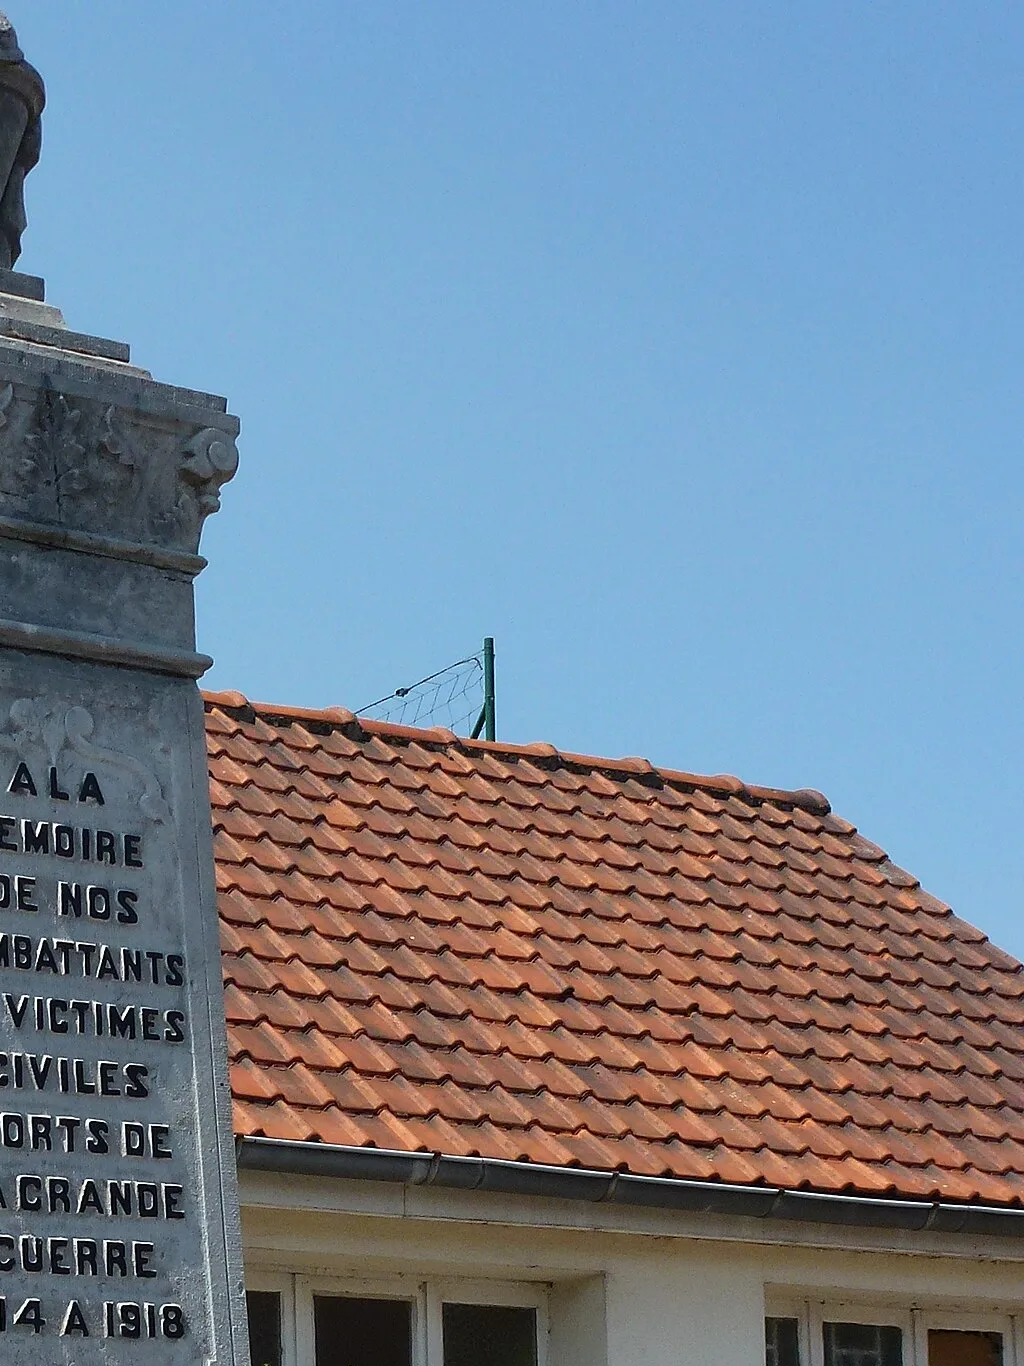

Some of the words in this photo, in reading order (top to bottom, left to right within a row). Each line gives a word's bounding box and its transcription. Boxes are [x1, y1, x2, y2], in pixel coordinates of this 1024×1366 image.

[7, 761, 38, 796] A
[48, 766, 106, 806] LA
[56, 881, 140, 925] NOS
[3, 992, 185, 1044] VICTIMES
[120, 1121, 173, 1158] DE
[16, 1174, 186, 1219] GRANDE
[59, 1300, 89, 1337] A
[103, 1301, 184, 1338] 1918
